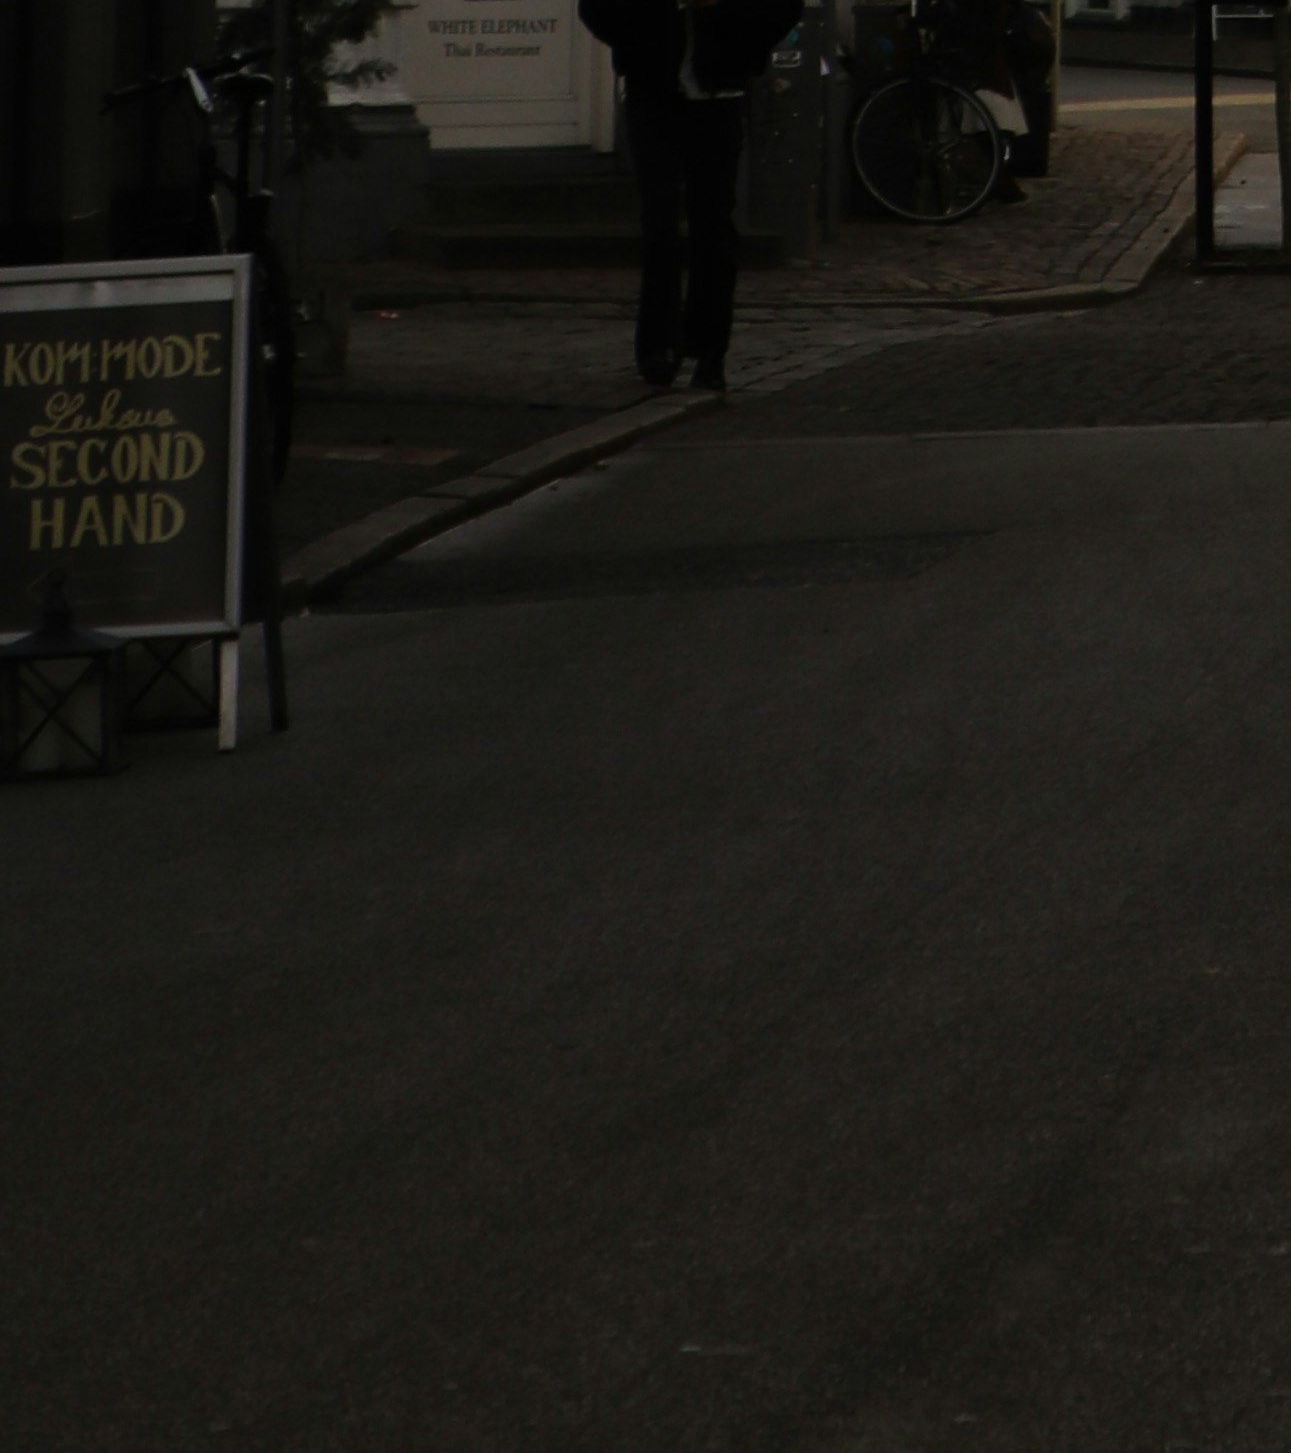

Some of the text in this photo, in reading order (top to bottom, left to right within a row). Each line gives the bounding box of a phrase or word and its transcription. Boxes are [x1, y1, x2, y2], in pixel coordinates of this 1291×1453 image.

[427, 19, 558, 35] WHITE ELEPHANT
[444, 43, 541, 58] Thai Restaurant
[10, 430, 206, 490] SECOND
[29, 490, 186, 552] HAND
